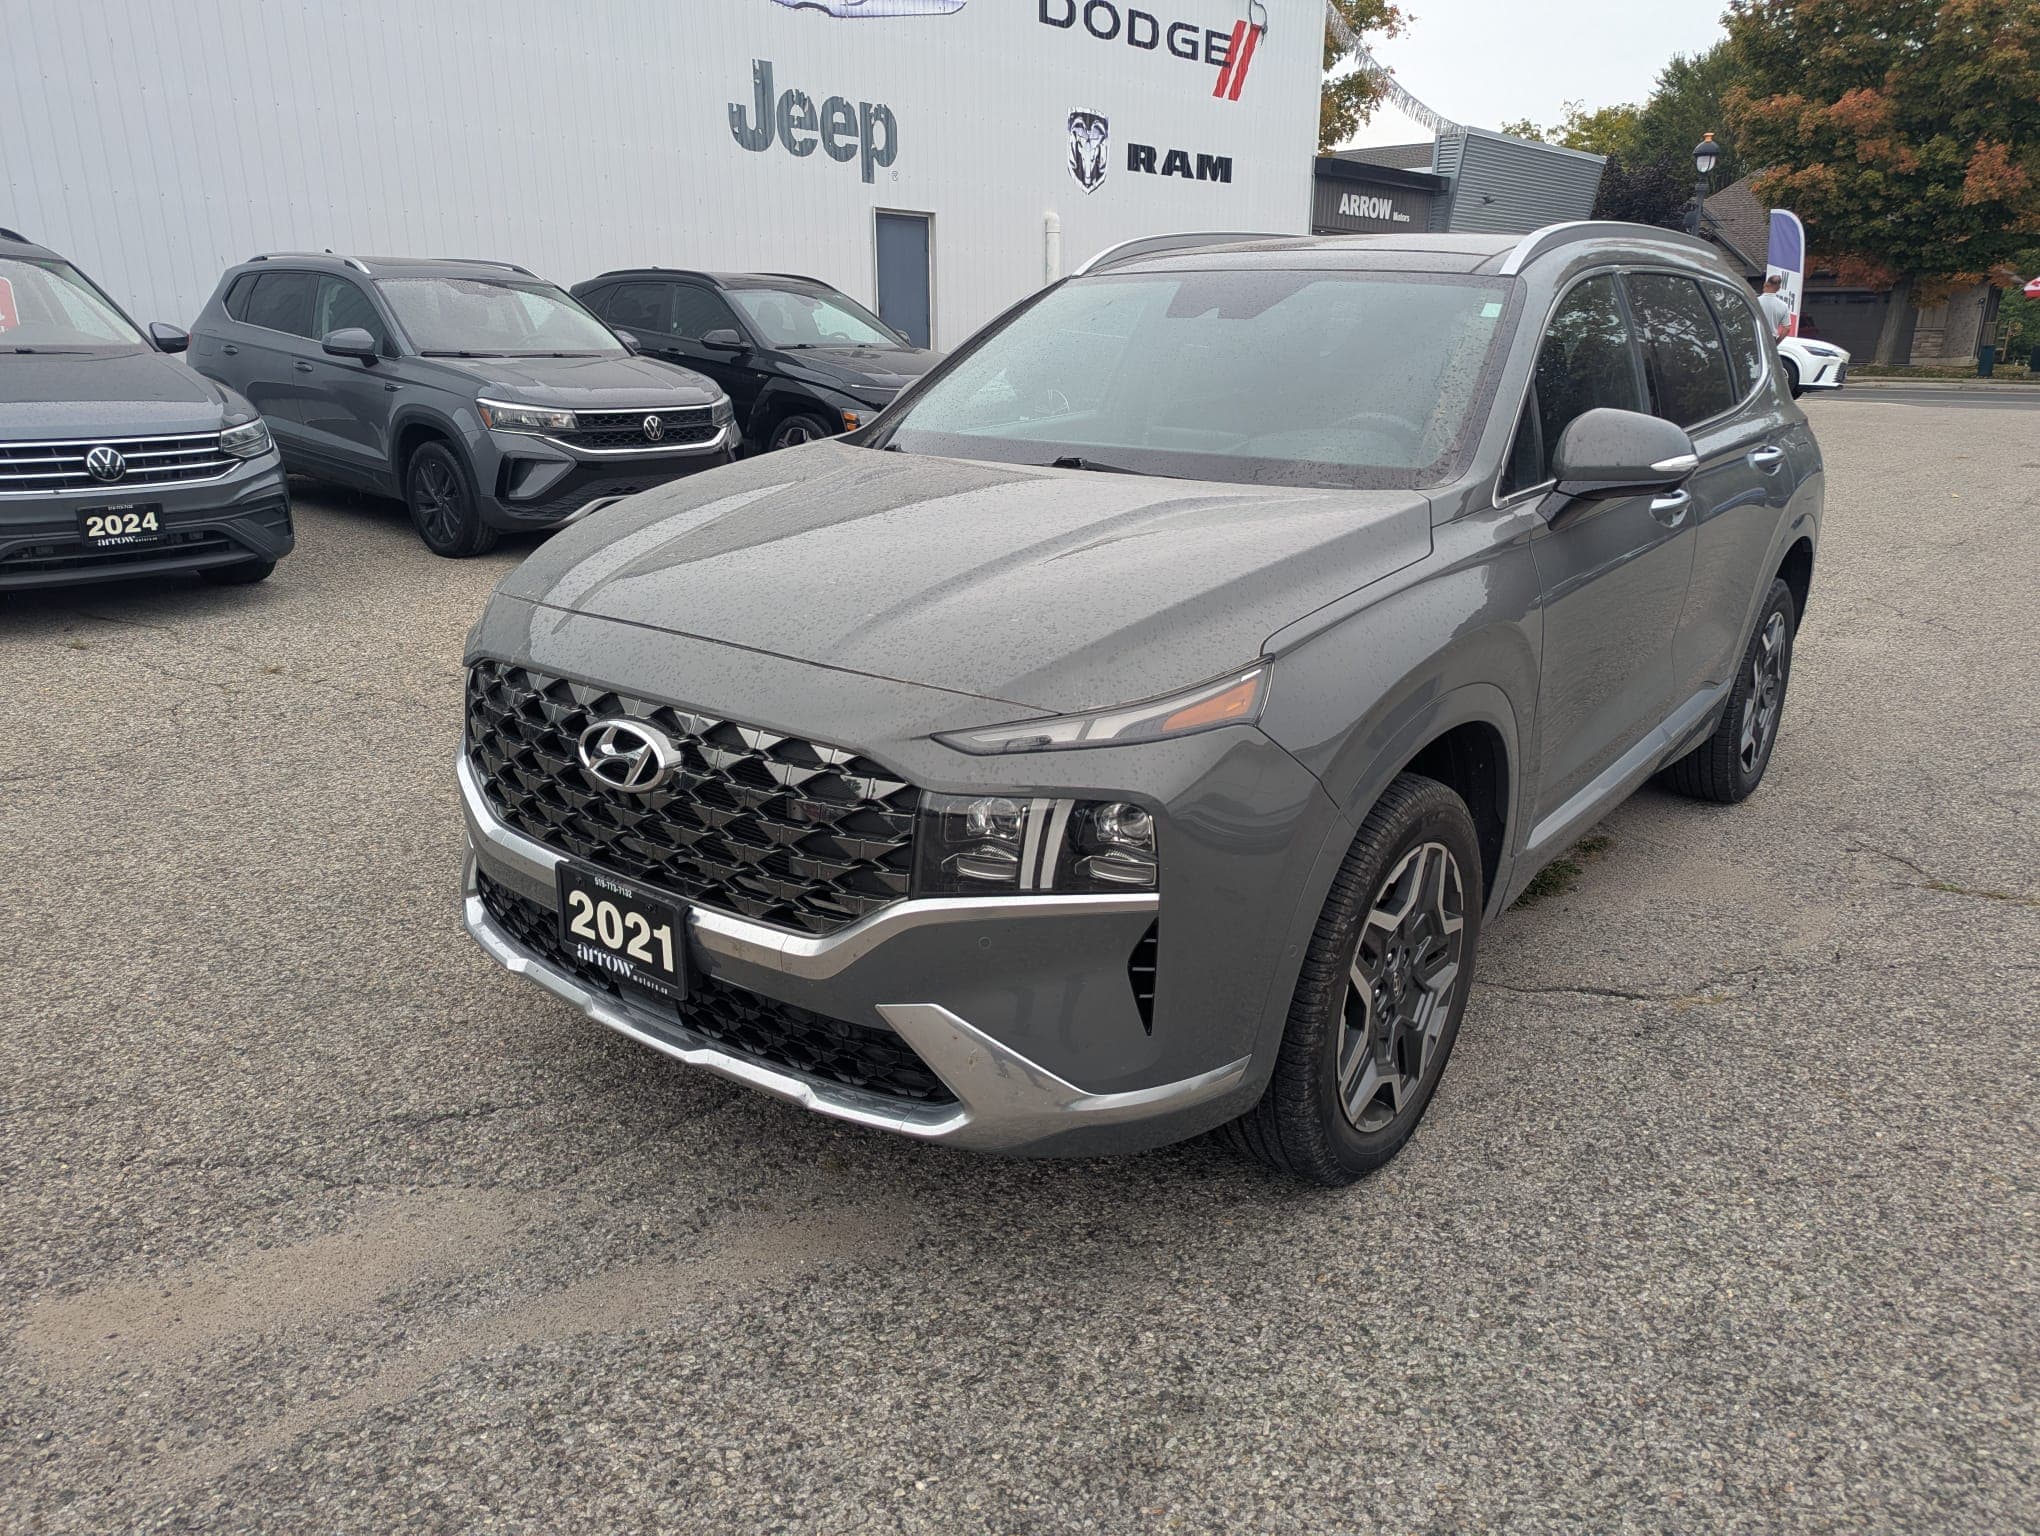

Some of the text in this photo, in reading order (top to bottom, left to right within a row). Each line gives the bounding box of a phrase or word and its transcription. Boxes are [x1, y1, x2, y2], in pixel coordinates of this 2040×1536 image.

[1038, 0, 1233, 68] DODGE
[727, 58, 898, 185] Jeep
[1126, 142, 1233, 184] RAM
[1338, 193, 1393, 220] ARROW
[86, 511, 159, 537] 2024
[568, 889, 674, 973] 2021
